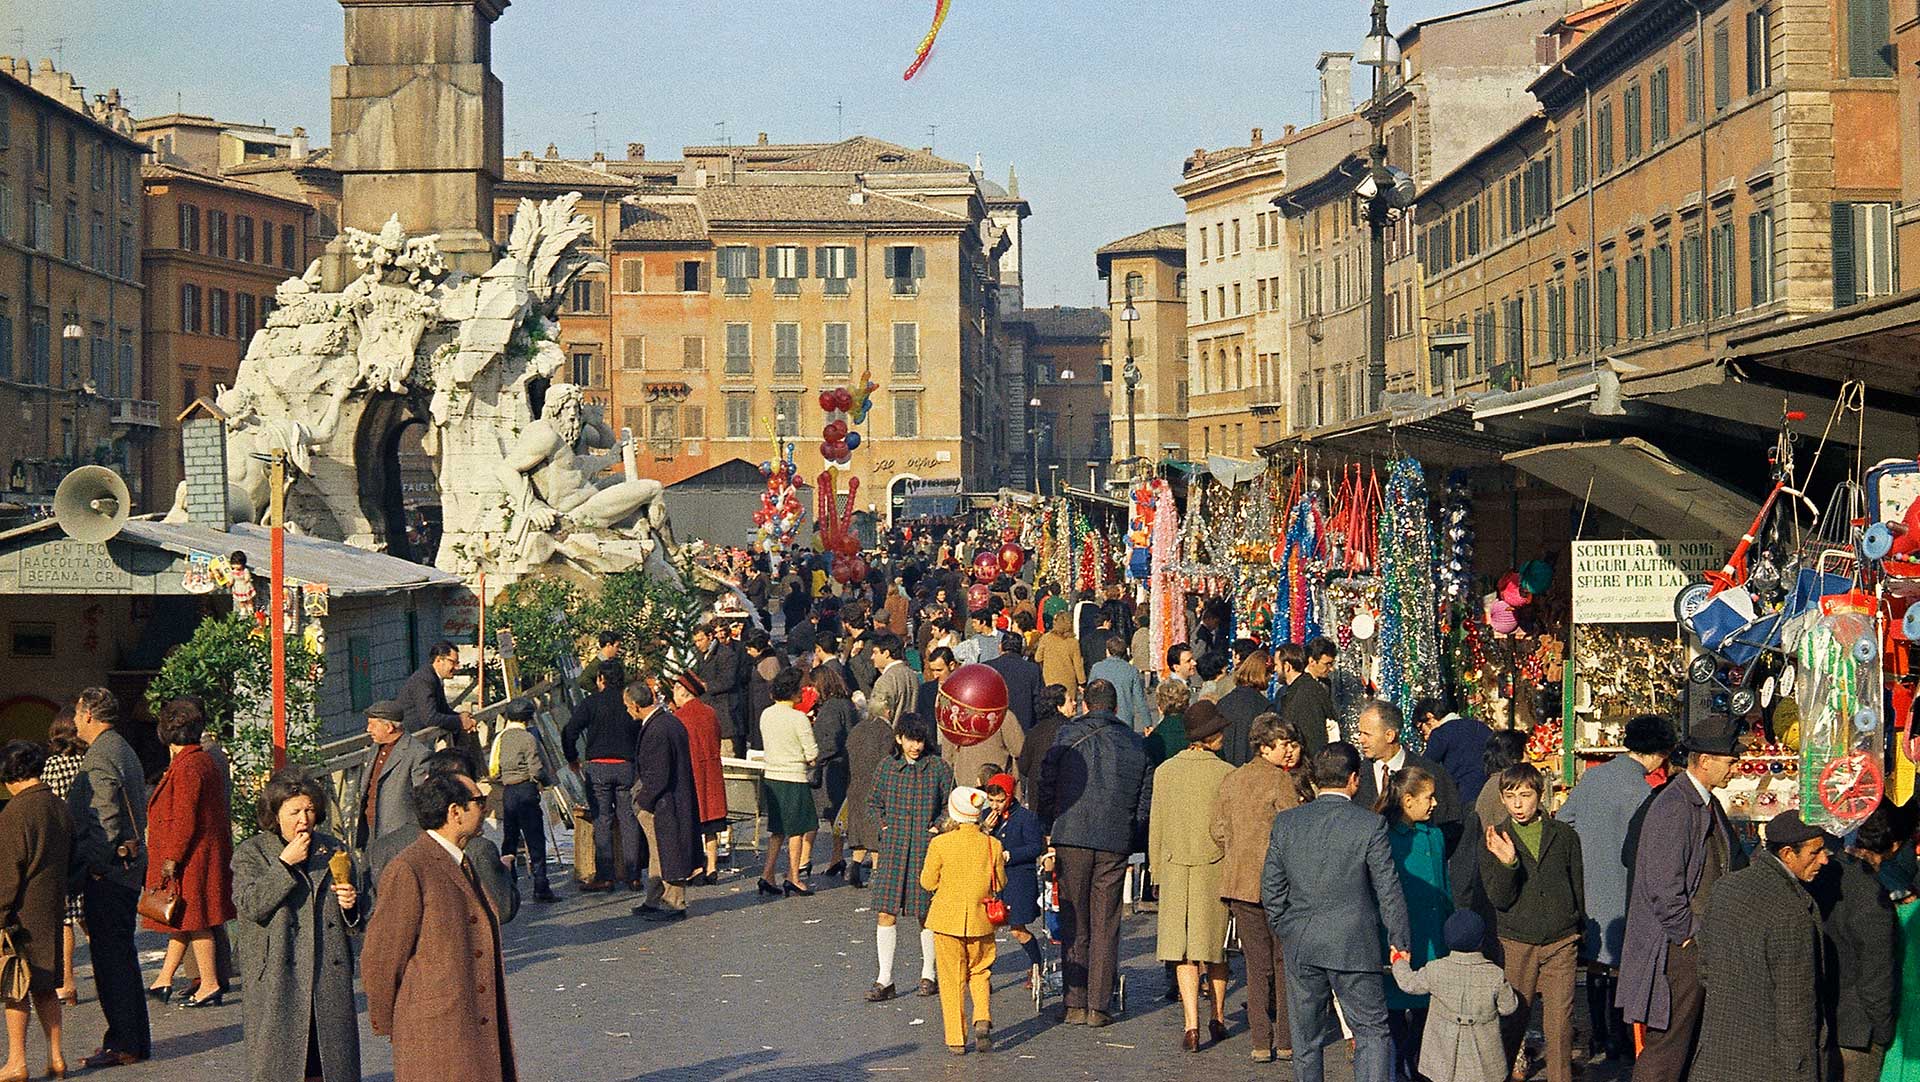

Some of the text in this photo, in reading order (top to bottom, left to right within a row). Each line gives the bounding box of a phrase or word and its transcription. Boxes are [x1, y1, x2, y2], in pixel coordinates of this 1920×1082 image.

[42, 543, 105, 555] CENTRO
[1576, 544, 1654, 558] SCRITTURA
[1657, 543, 1672, 557] DI
[23, 557, 90, 569] RACCOLTA
[1680, 558, 1721, 571] SULLE
[1576, 574, 1621, 588] SFERE
[1625, 574, 1654, 587] PER
